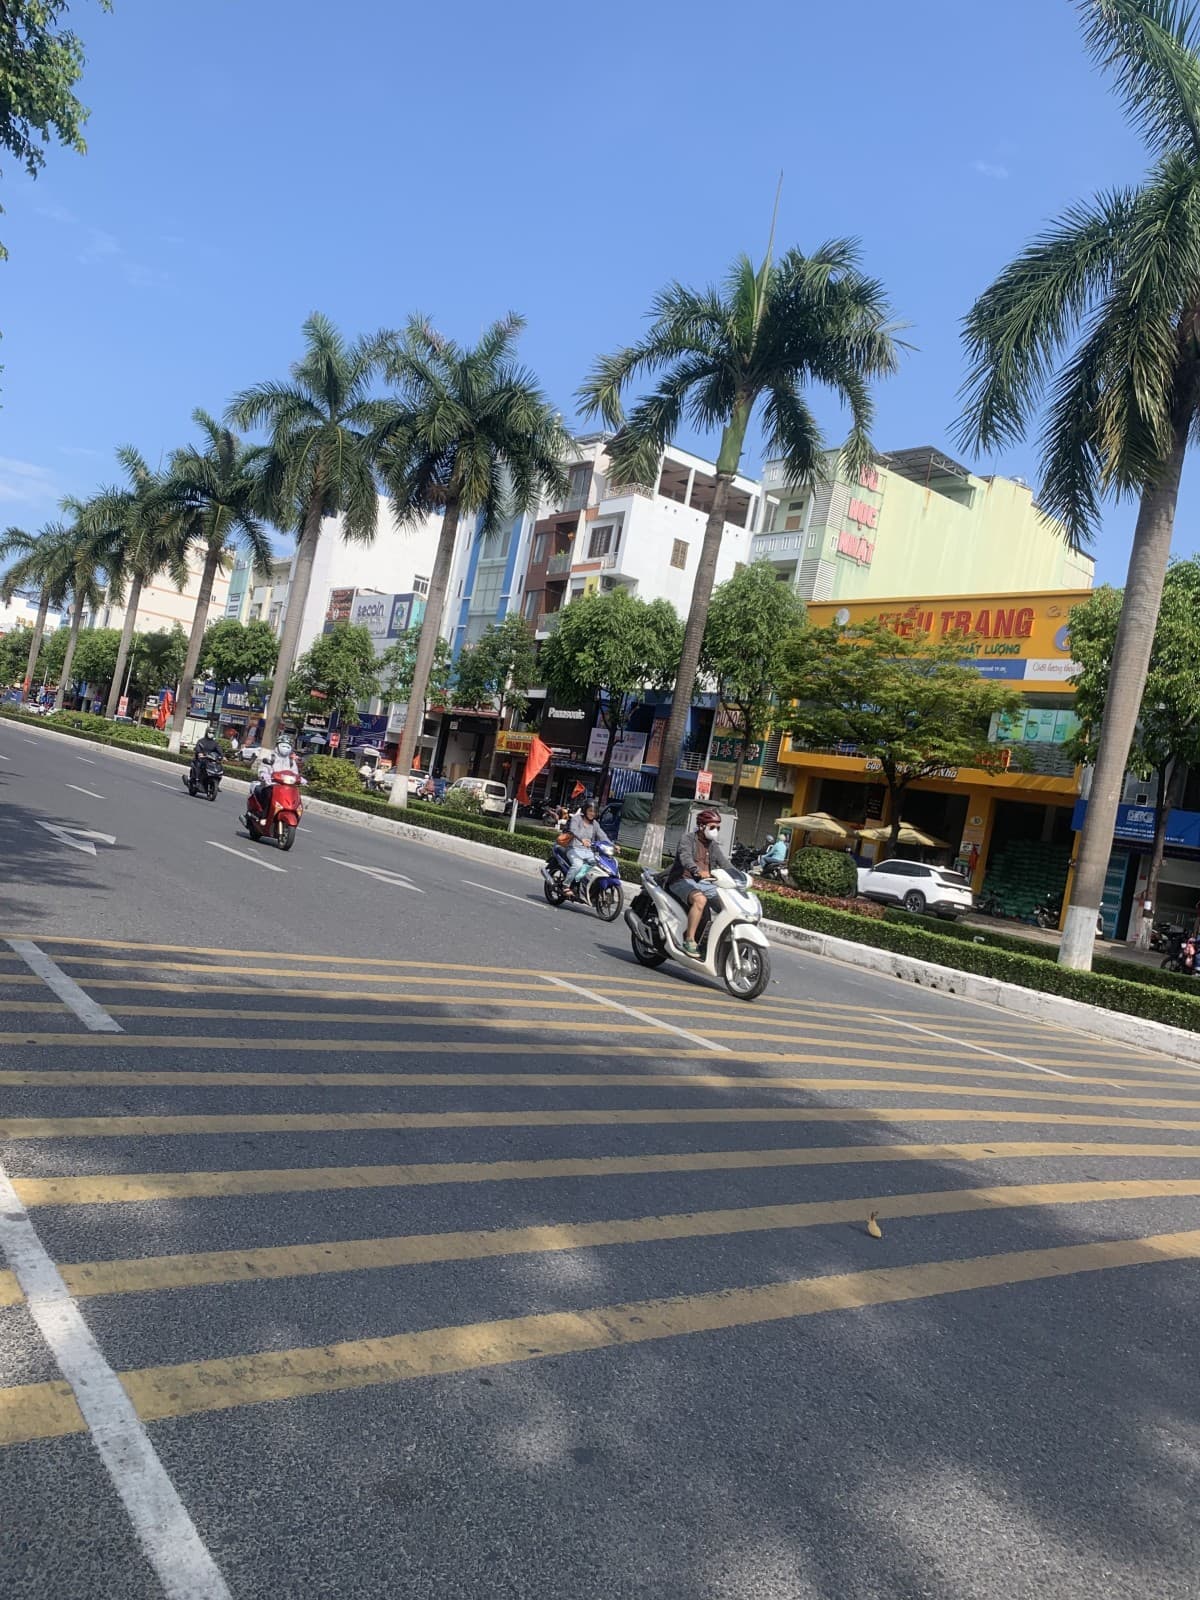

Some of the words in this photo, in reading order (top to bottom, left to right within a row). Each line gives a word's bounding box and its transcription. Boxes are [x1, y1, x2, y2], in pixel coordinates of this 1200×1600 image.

[847, 497, 879, 530] HỌC
[941, 607, 1034, 638] TRANG
[984, 643, 1021, 656] LƯỢNG
[548, 707, 585, 720] Panasonic
